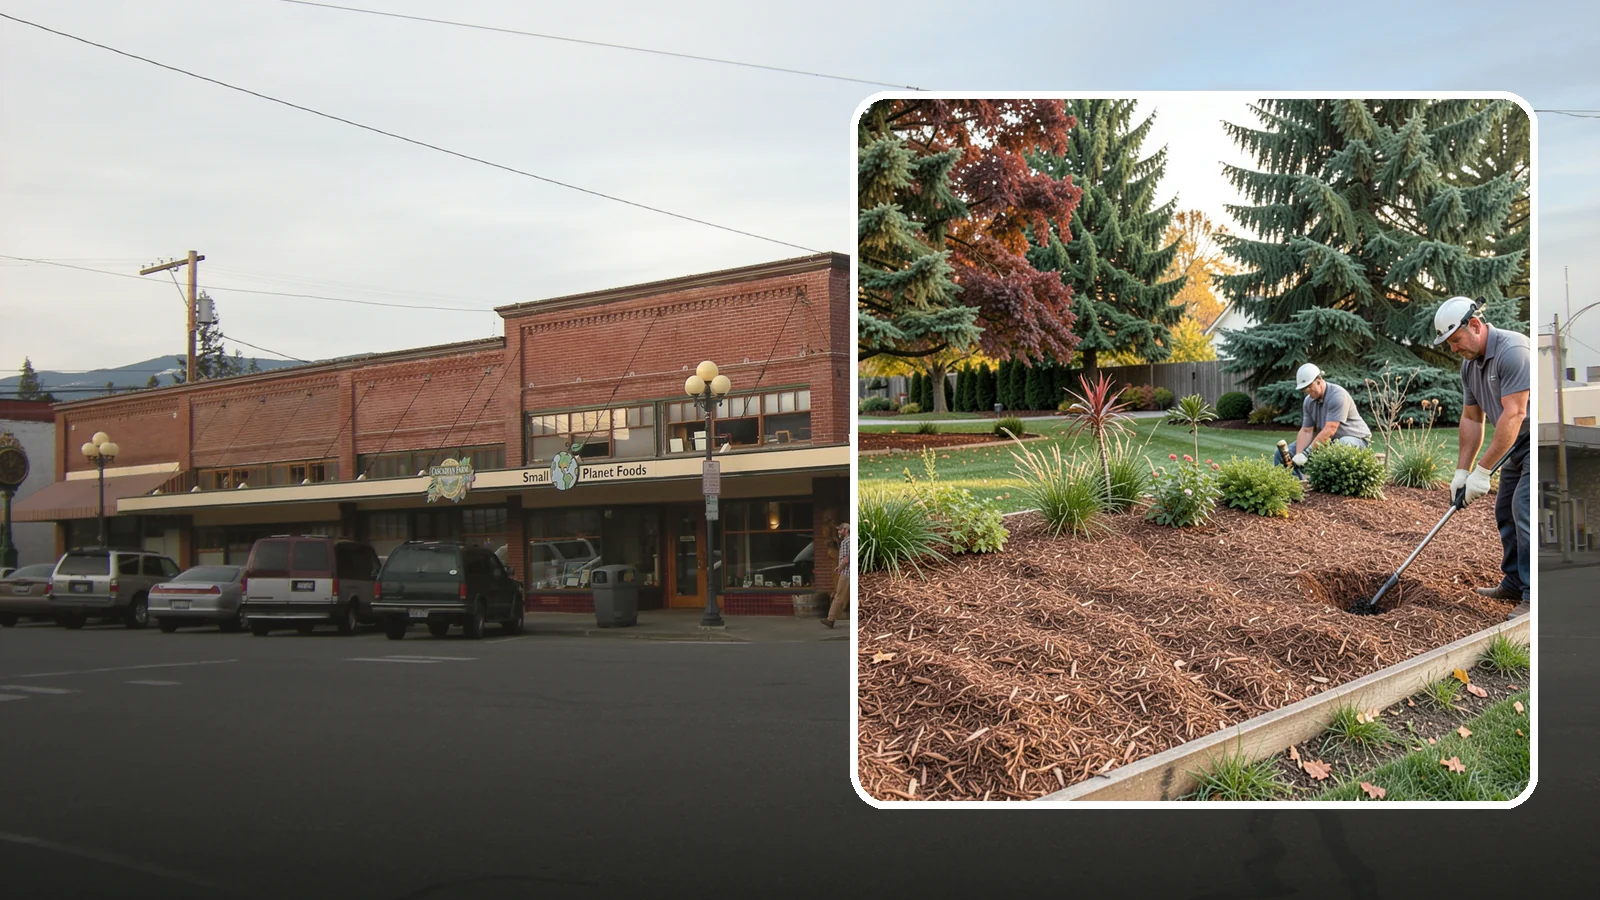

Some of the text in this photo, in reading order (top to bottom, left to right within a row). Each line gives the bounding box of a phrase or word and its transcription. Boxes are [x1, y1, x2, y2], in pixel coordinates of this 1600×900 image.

[523, 464, 647, 483] Small Planet Foods
